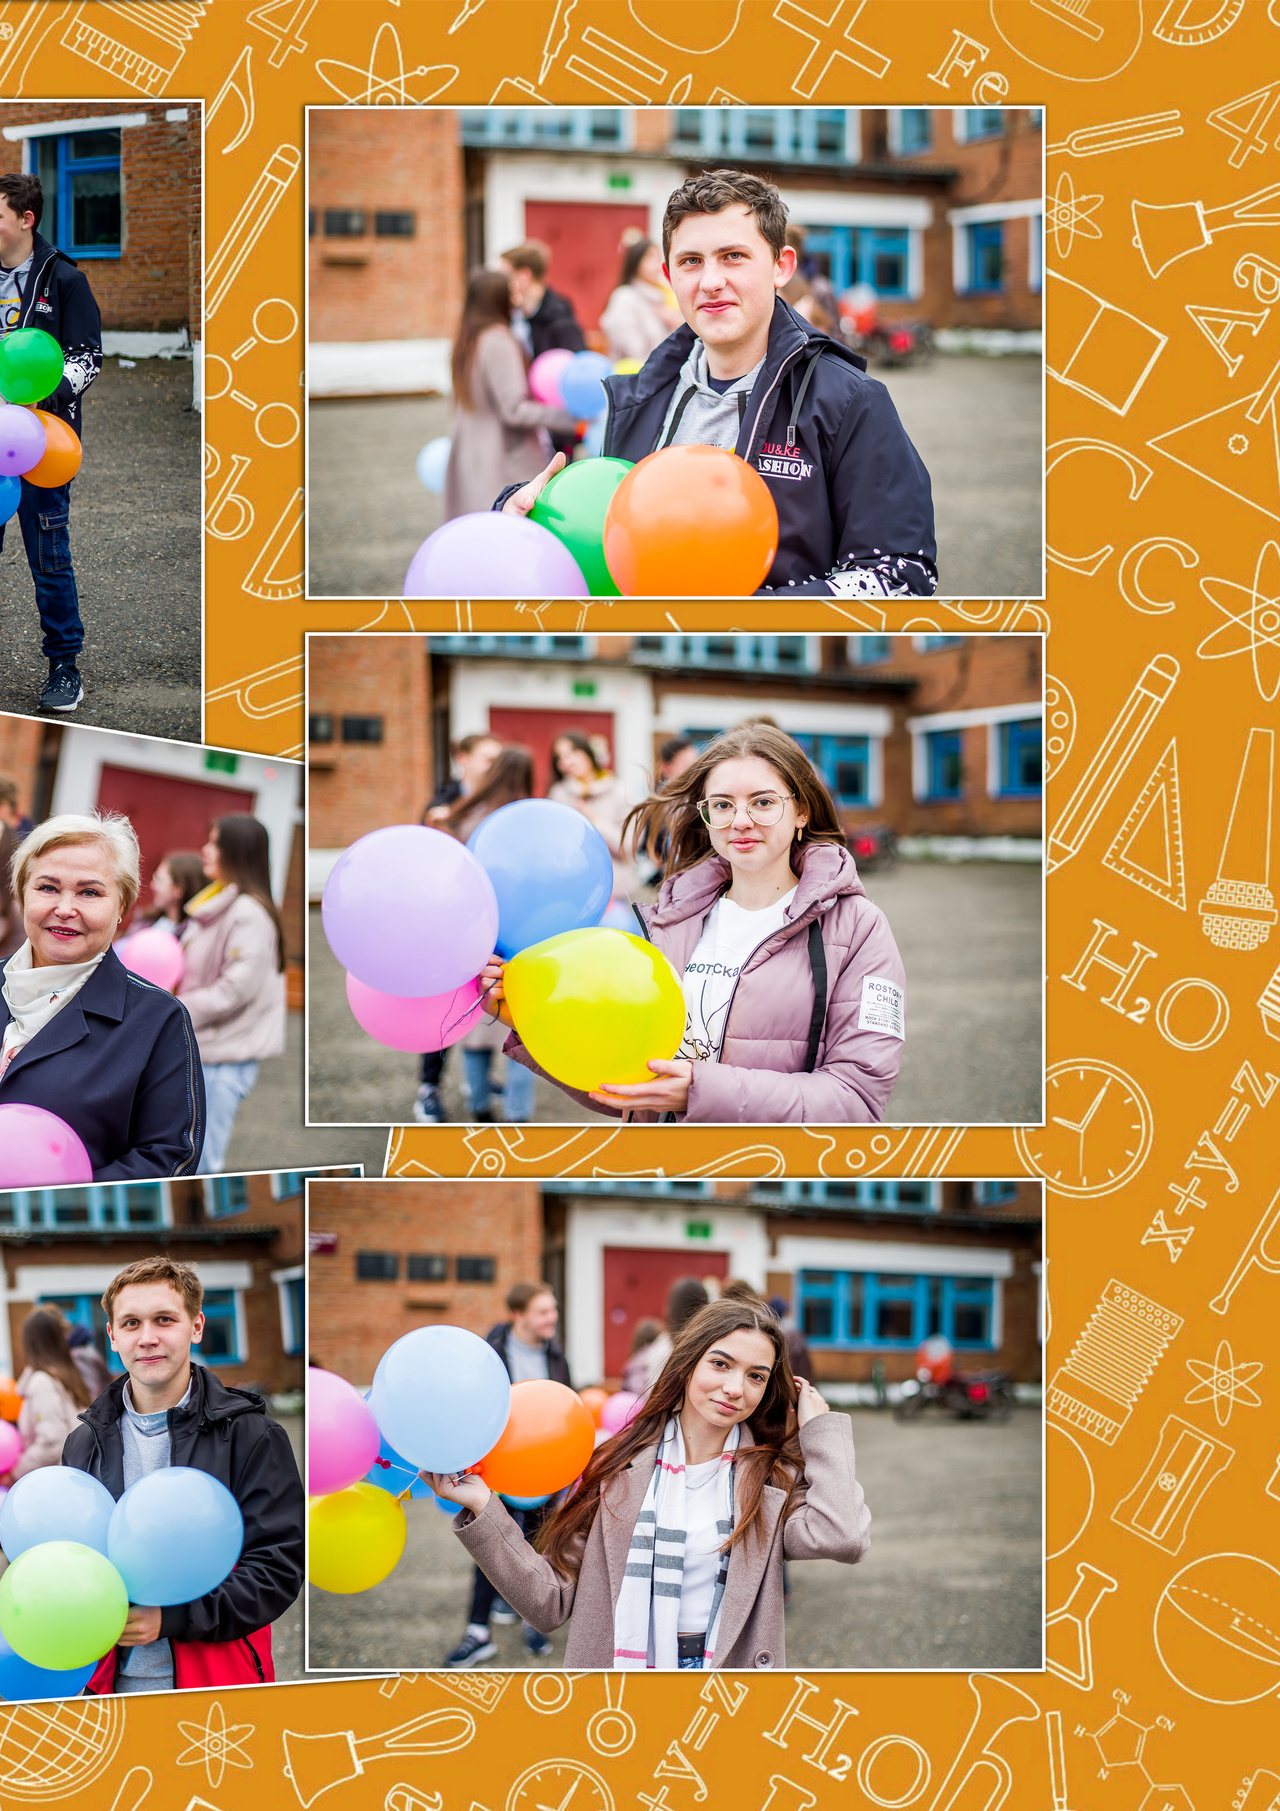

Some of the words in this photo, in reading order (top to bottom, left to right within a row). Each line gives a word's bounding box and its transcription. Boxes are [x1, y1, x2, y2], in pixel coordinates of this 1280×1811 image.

[927, 29, 1009, 105] Fe
[876, 994, 899, 1007] CHILD
[1112, 1689, 1131, 1705] CN
[1073, 1725, 1086, 1737] H
[1155, 1715, 1176, 1732] CN
[1096, 1767, 1110, 1781] N
